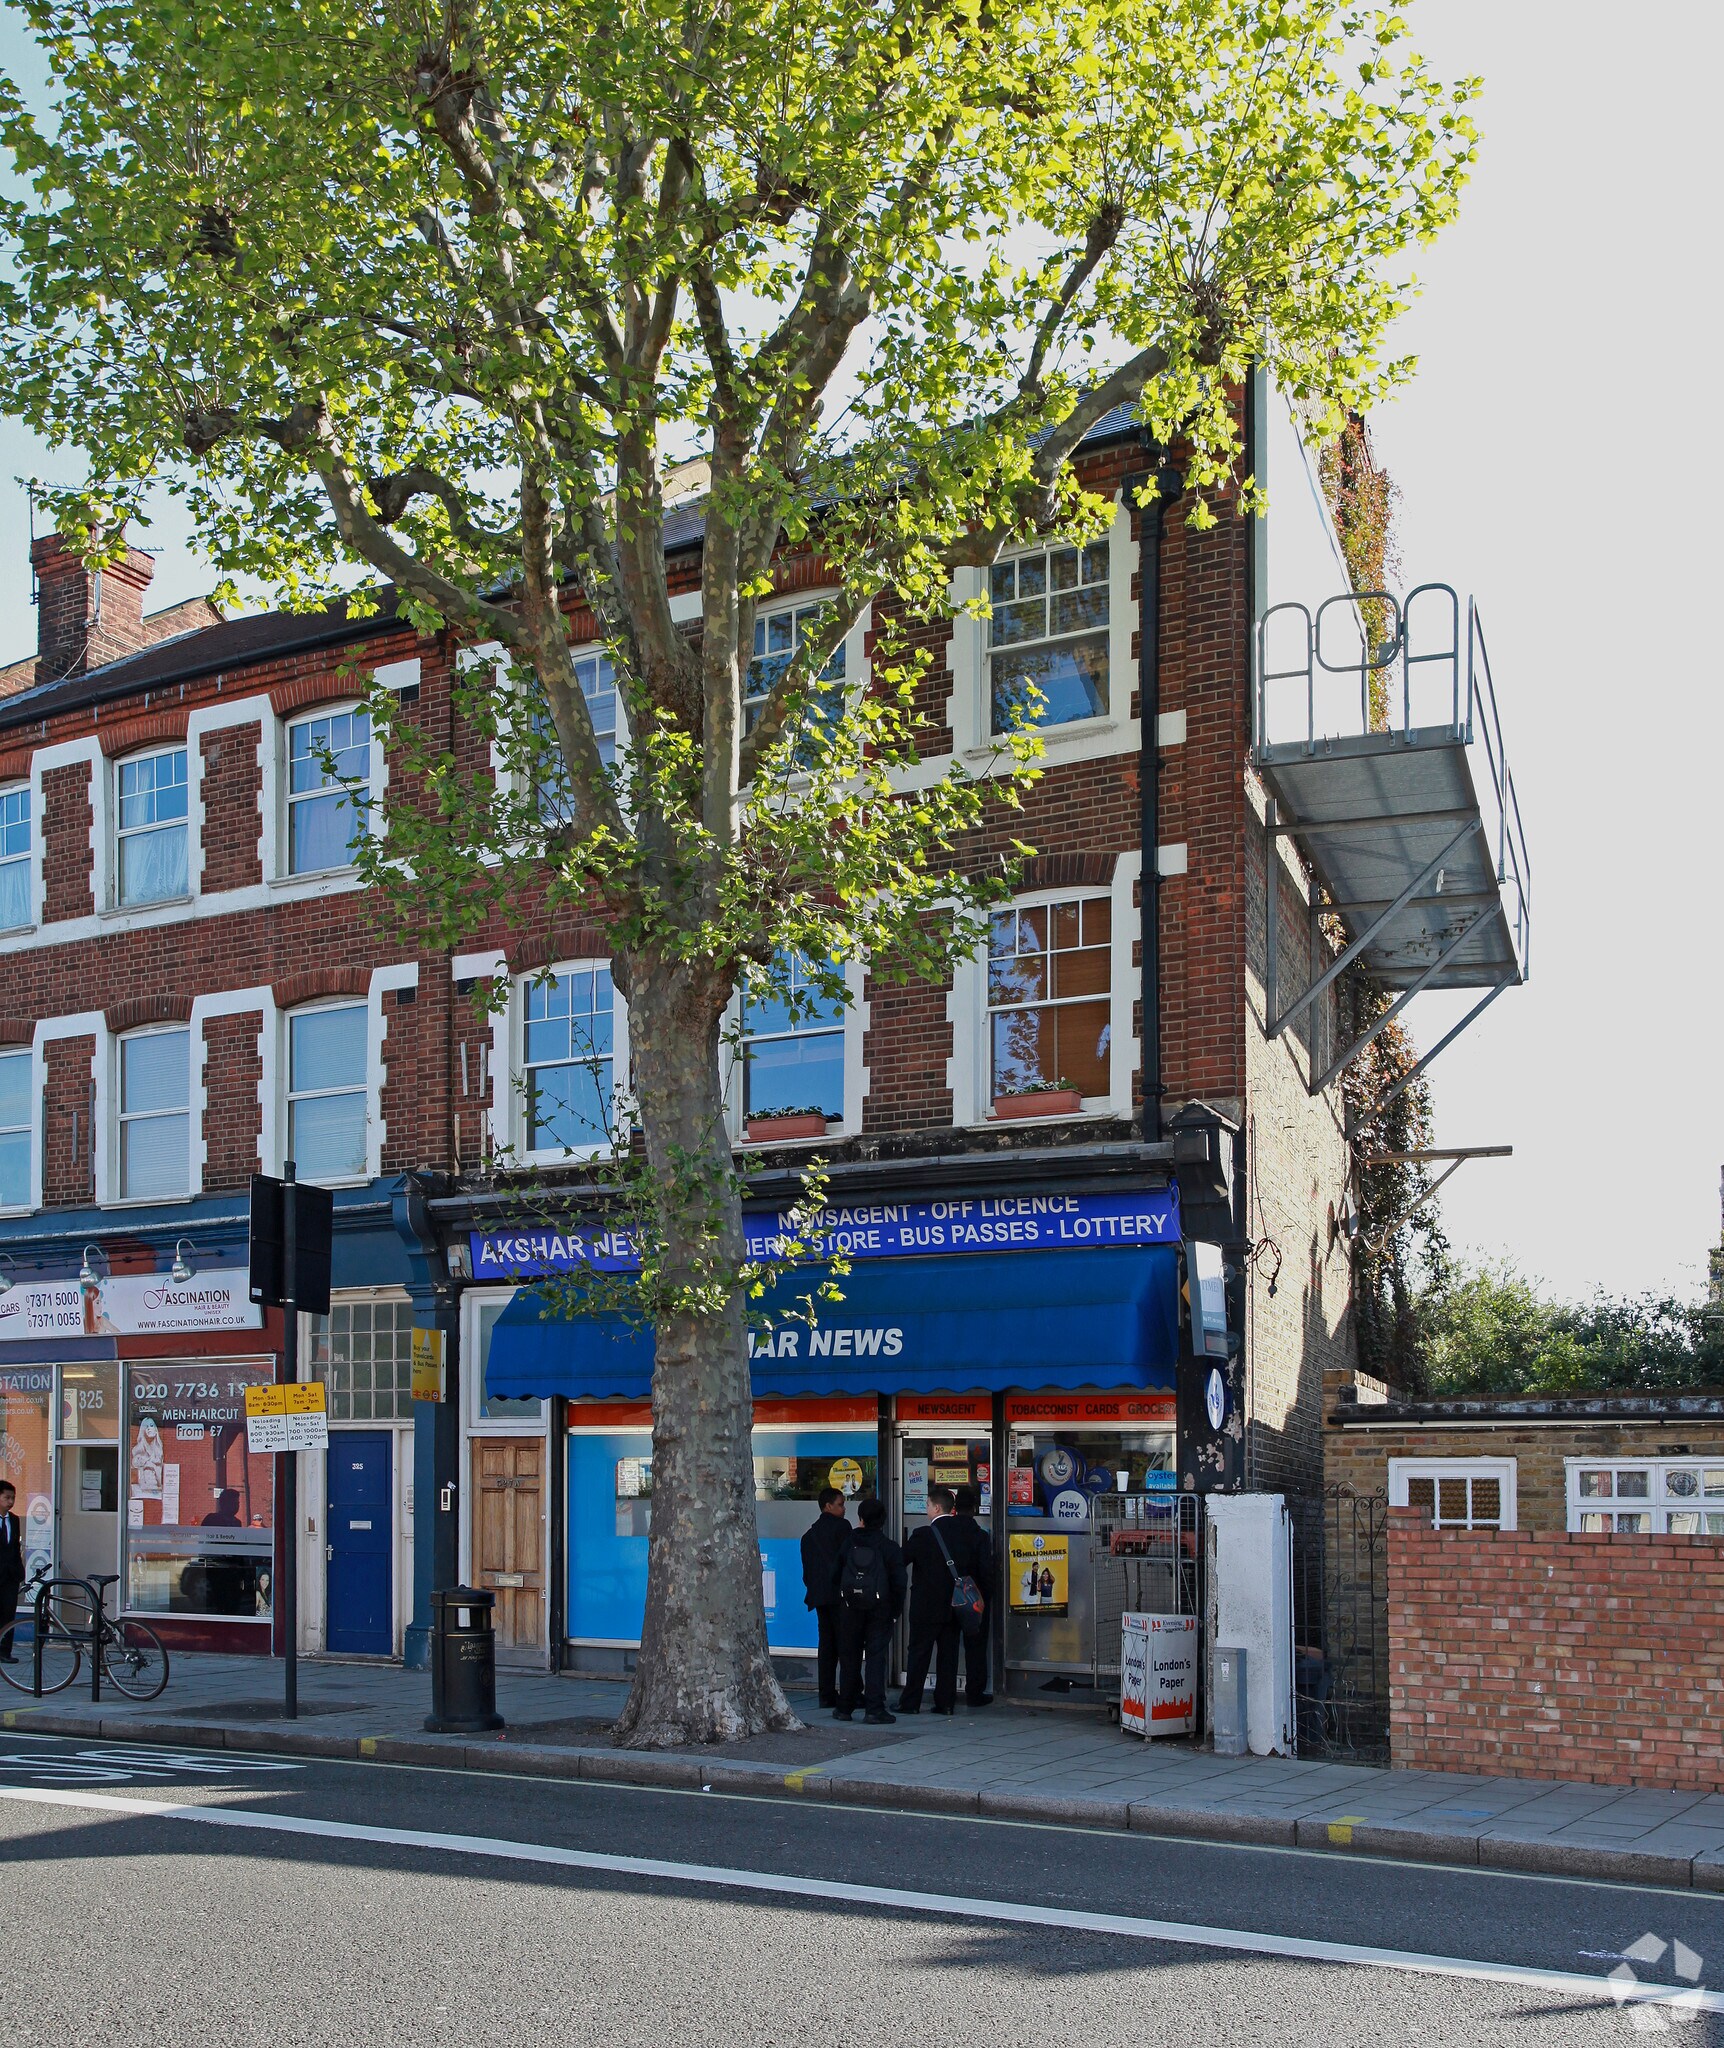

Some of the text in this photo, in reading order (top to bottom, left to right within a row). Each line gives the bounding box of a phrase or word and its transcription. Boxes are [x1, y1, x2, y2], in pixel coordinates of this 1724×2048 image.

[931, 1200, 973, 1220] OFF
[980, 1196, 1080, 1217] LICENCE
[811, 1229, 881, 1252] STORE
[900, 1225, 945, 1247] BUS
[952, 1220, 1039, 1244] PASSES
[1059, 1213, 1168, 1239] LOTTERY
[480, 1234, 586, 1265] AKSHAR
[29, 1291, 79, 1308] 7371 5000
[1, 1302, 20, 1314] CARS
[32, 1312, 81, 1328] 7371 0055
[137, 1316, 246, 1329] WWW.FASCINATIONHAIR.CO.UK
[808, 1328, 904, 1357] NEWS
[134, 1383, 169, 1399] 020
[174, 1382, 220, 1398] 7736
[79, 1390, 104, 1409] 325
[162, 1408, 239, 1421] MEN-HAIRCUT
[917, 1403, 977, 1415] NEWSAGENT
[1011, 1403, 1079, 1415] TOBACCONIST
[1085, 1403, 1119, 1415] CARDS
[177, 1425, 224, 1437] From £7
[934, 1450, 966, 1458] SMOKING
[909, 1476, 923, 1484] HERE
[1059, 1500, 1080, 1511] Play
[1058, 1508, 1081, 1518] here
[1011, 1548, 1067, 1558] 18 MILLIONAIRES
[1153, 1658, 1191, 1672] London's
[1160, 1677, 1185, 1690] Paper
